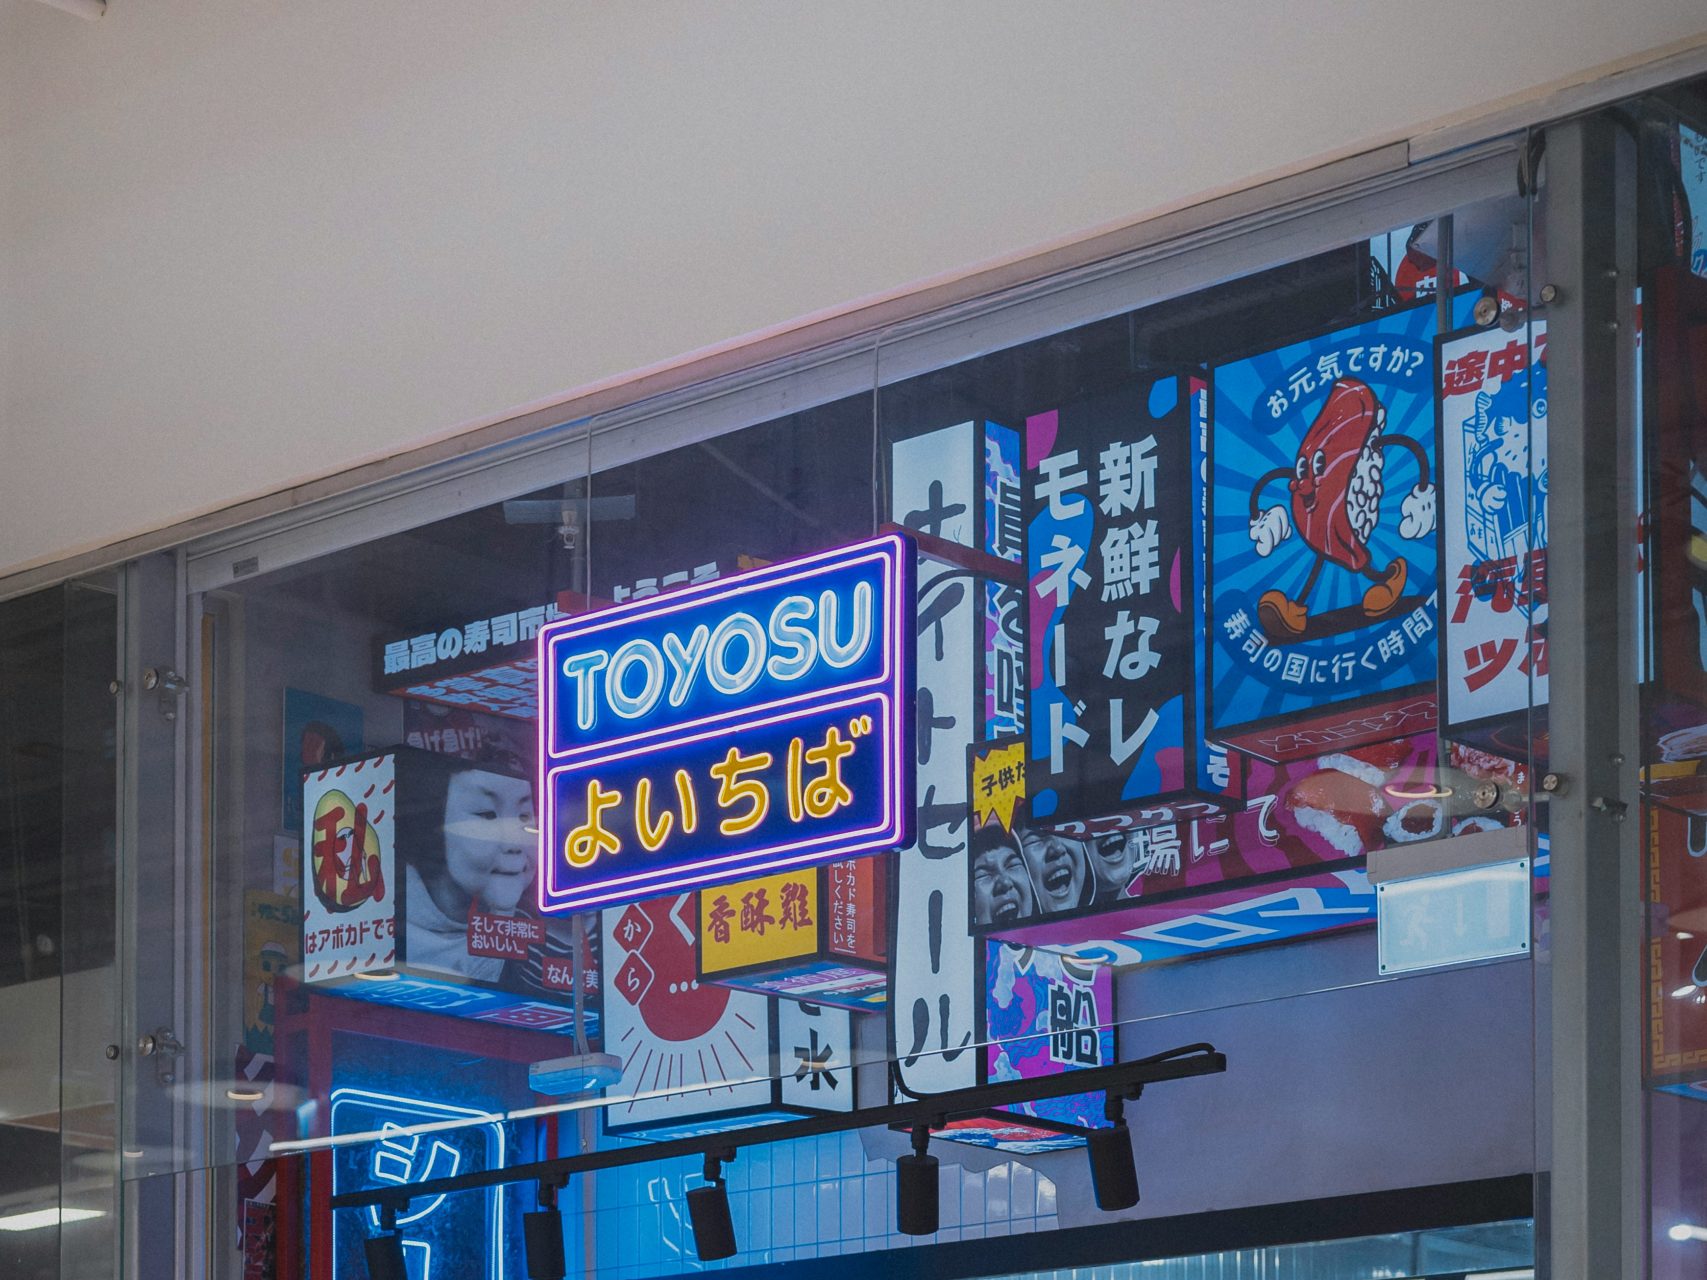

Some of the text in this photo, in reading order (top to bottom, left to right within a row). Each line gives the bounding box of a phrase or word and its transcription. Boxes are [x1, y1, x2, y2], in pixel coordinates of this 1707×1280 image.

[1267, 344, 1424, 418] お元気ですか?
[1035, 450, 1091, 774] モネード
[1100, 434, 1161, 766] 新鮮なレ
[564, 581, 873, 731] TOYOSU
[564, 714, 873, 868] よいちば
[313, 802, 385, 904] 私
[305, 917, 397, 954] はアボカドです
[472, 916, 540, 939] そして非常に
[547, 963, 599, 989] なん美
